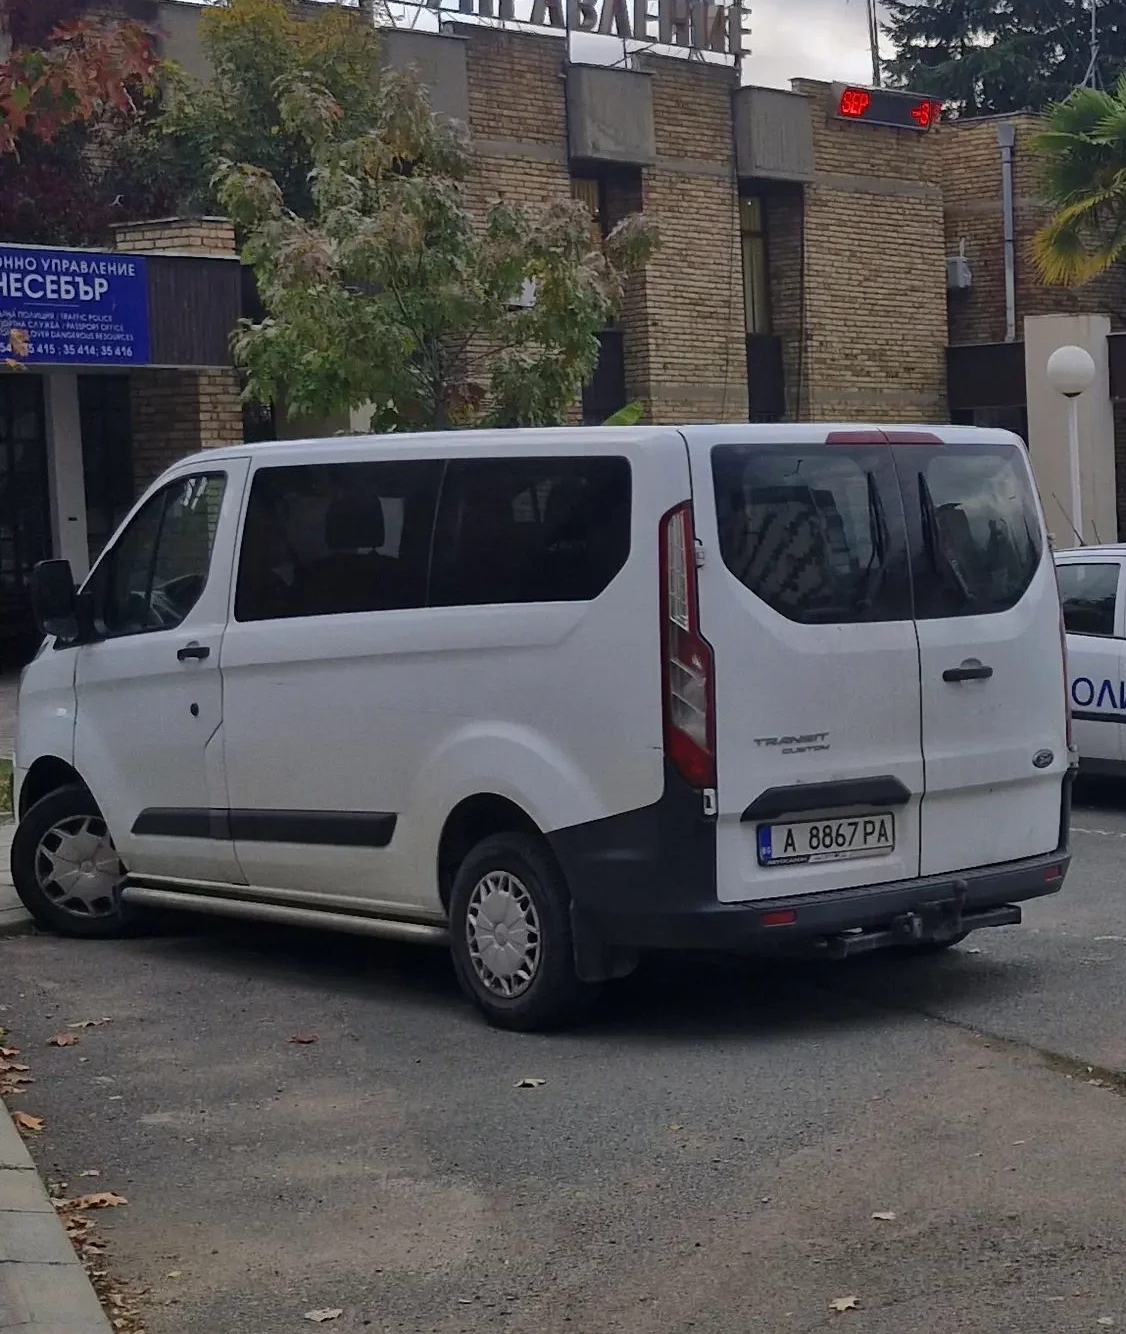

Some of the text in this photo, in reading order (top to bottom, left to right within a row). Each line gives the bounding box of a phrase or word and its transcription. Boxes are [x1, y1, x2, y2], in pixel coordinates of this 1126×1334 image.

[41, 257, 136, 276] УПРАВЛЕНИЕ
[88, 314, 113, 323] POLICE
[66, 322, 99, 331] PASSPORT
[101, 324, 124, 332] OFFICE
[30, 330, 50, 338] OVER
[115, 345, 133, 357] 416
[753, 732, 829, 747] TRANSIT
